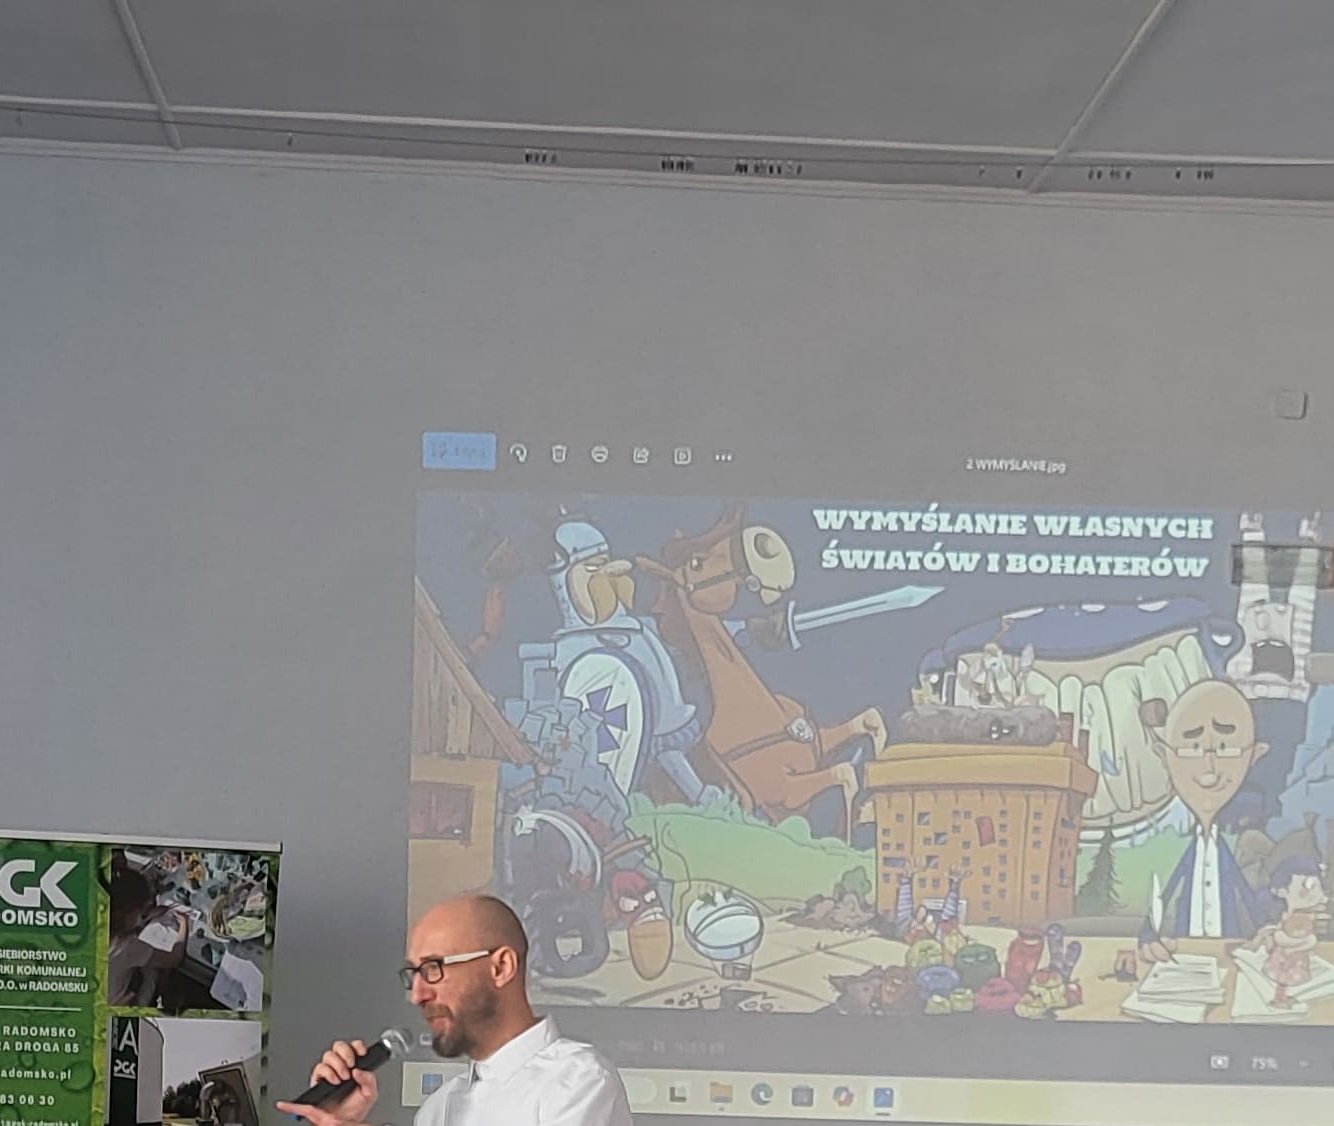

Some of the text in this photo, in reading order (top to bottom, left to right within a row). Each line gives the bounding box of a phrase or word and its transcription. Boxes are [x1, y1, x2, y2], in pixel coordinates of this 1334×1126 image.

[812, 502, 1214, 539] WYMYŚLANIE WŁASNYCH
[821, 539, 1209, 578] ŚWIATÓW I BOHATERÓW
[16, 964, 87, 978] KOMUNALNEJ
[28, 981, 88, 993] RADOMSKU
[2, 1025, 76, 1038] RADOMSKO
[15, 1041, 60, 1052] DROGA
